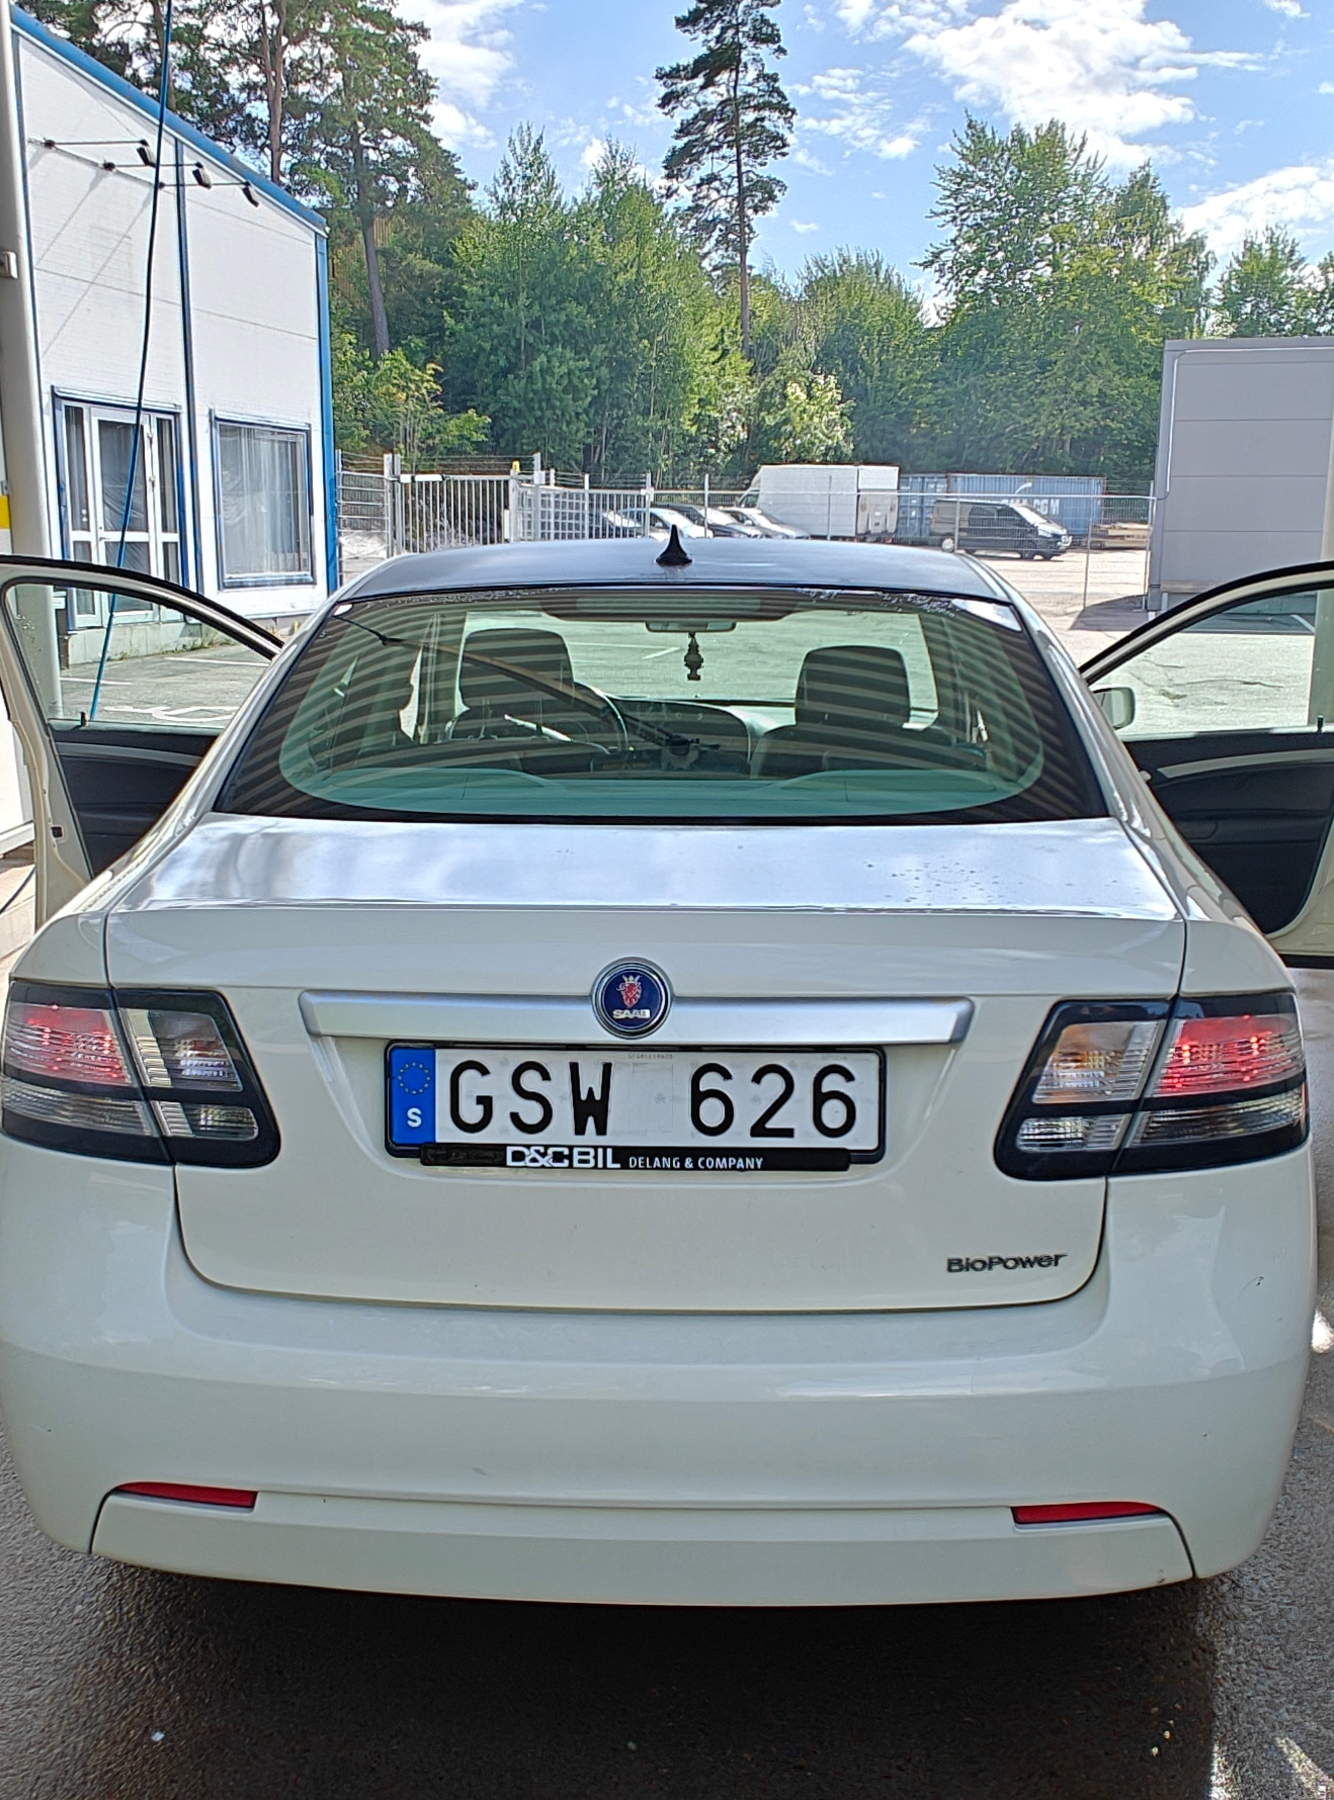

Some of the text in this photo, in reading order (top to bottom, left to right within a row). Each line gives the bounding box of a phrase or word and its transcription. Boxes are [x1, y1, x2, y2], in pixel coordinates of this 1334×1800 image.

[612, 1009, 651, 1019] SAAB
[450, 1060, 857, 1138] GSW 626
[407, 1107, 422, 1128] S
[629, 1156, 680, 1169] DELANG
[684, 1157, 694, 1168] &
[698, 1157, 764, 1169] COMPANY
[946, 1253, 1068, 1273] BioPower
